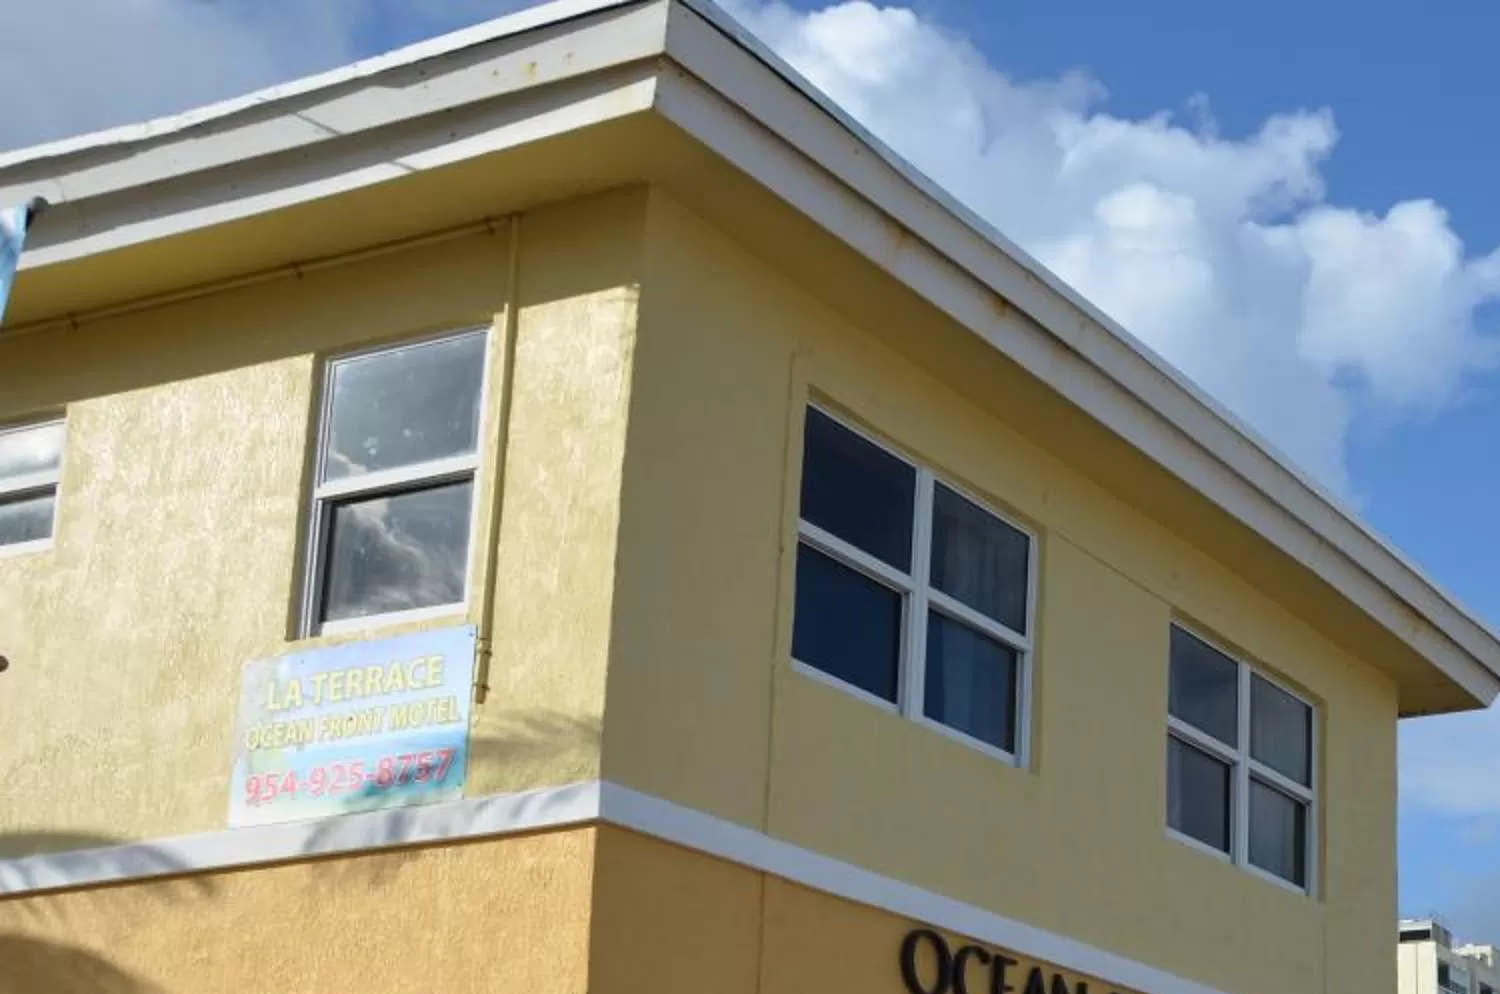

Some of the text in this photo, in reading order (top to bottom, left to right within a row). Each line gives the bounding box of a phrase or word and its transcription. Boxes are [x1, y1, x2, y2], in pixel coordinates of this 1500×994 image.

[269, 656, 443, 711] LA TERRACE
[246, 697, 460, 750] OCEAN FRONT MOTEL
[245, 748, 454, 803] 954-925-8757
